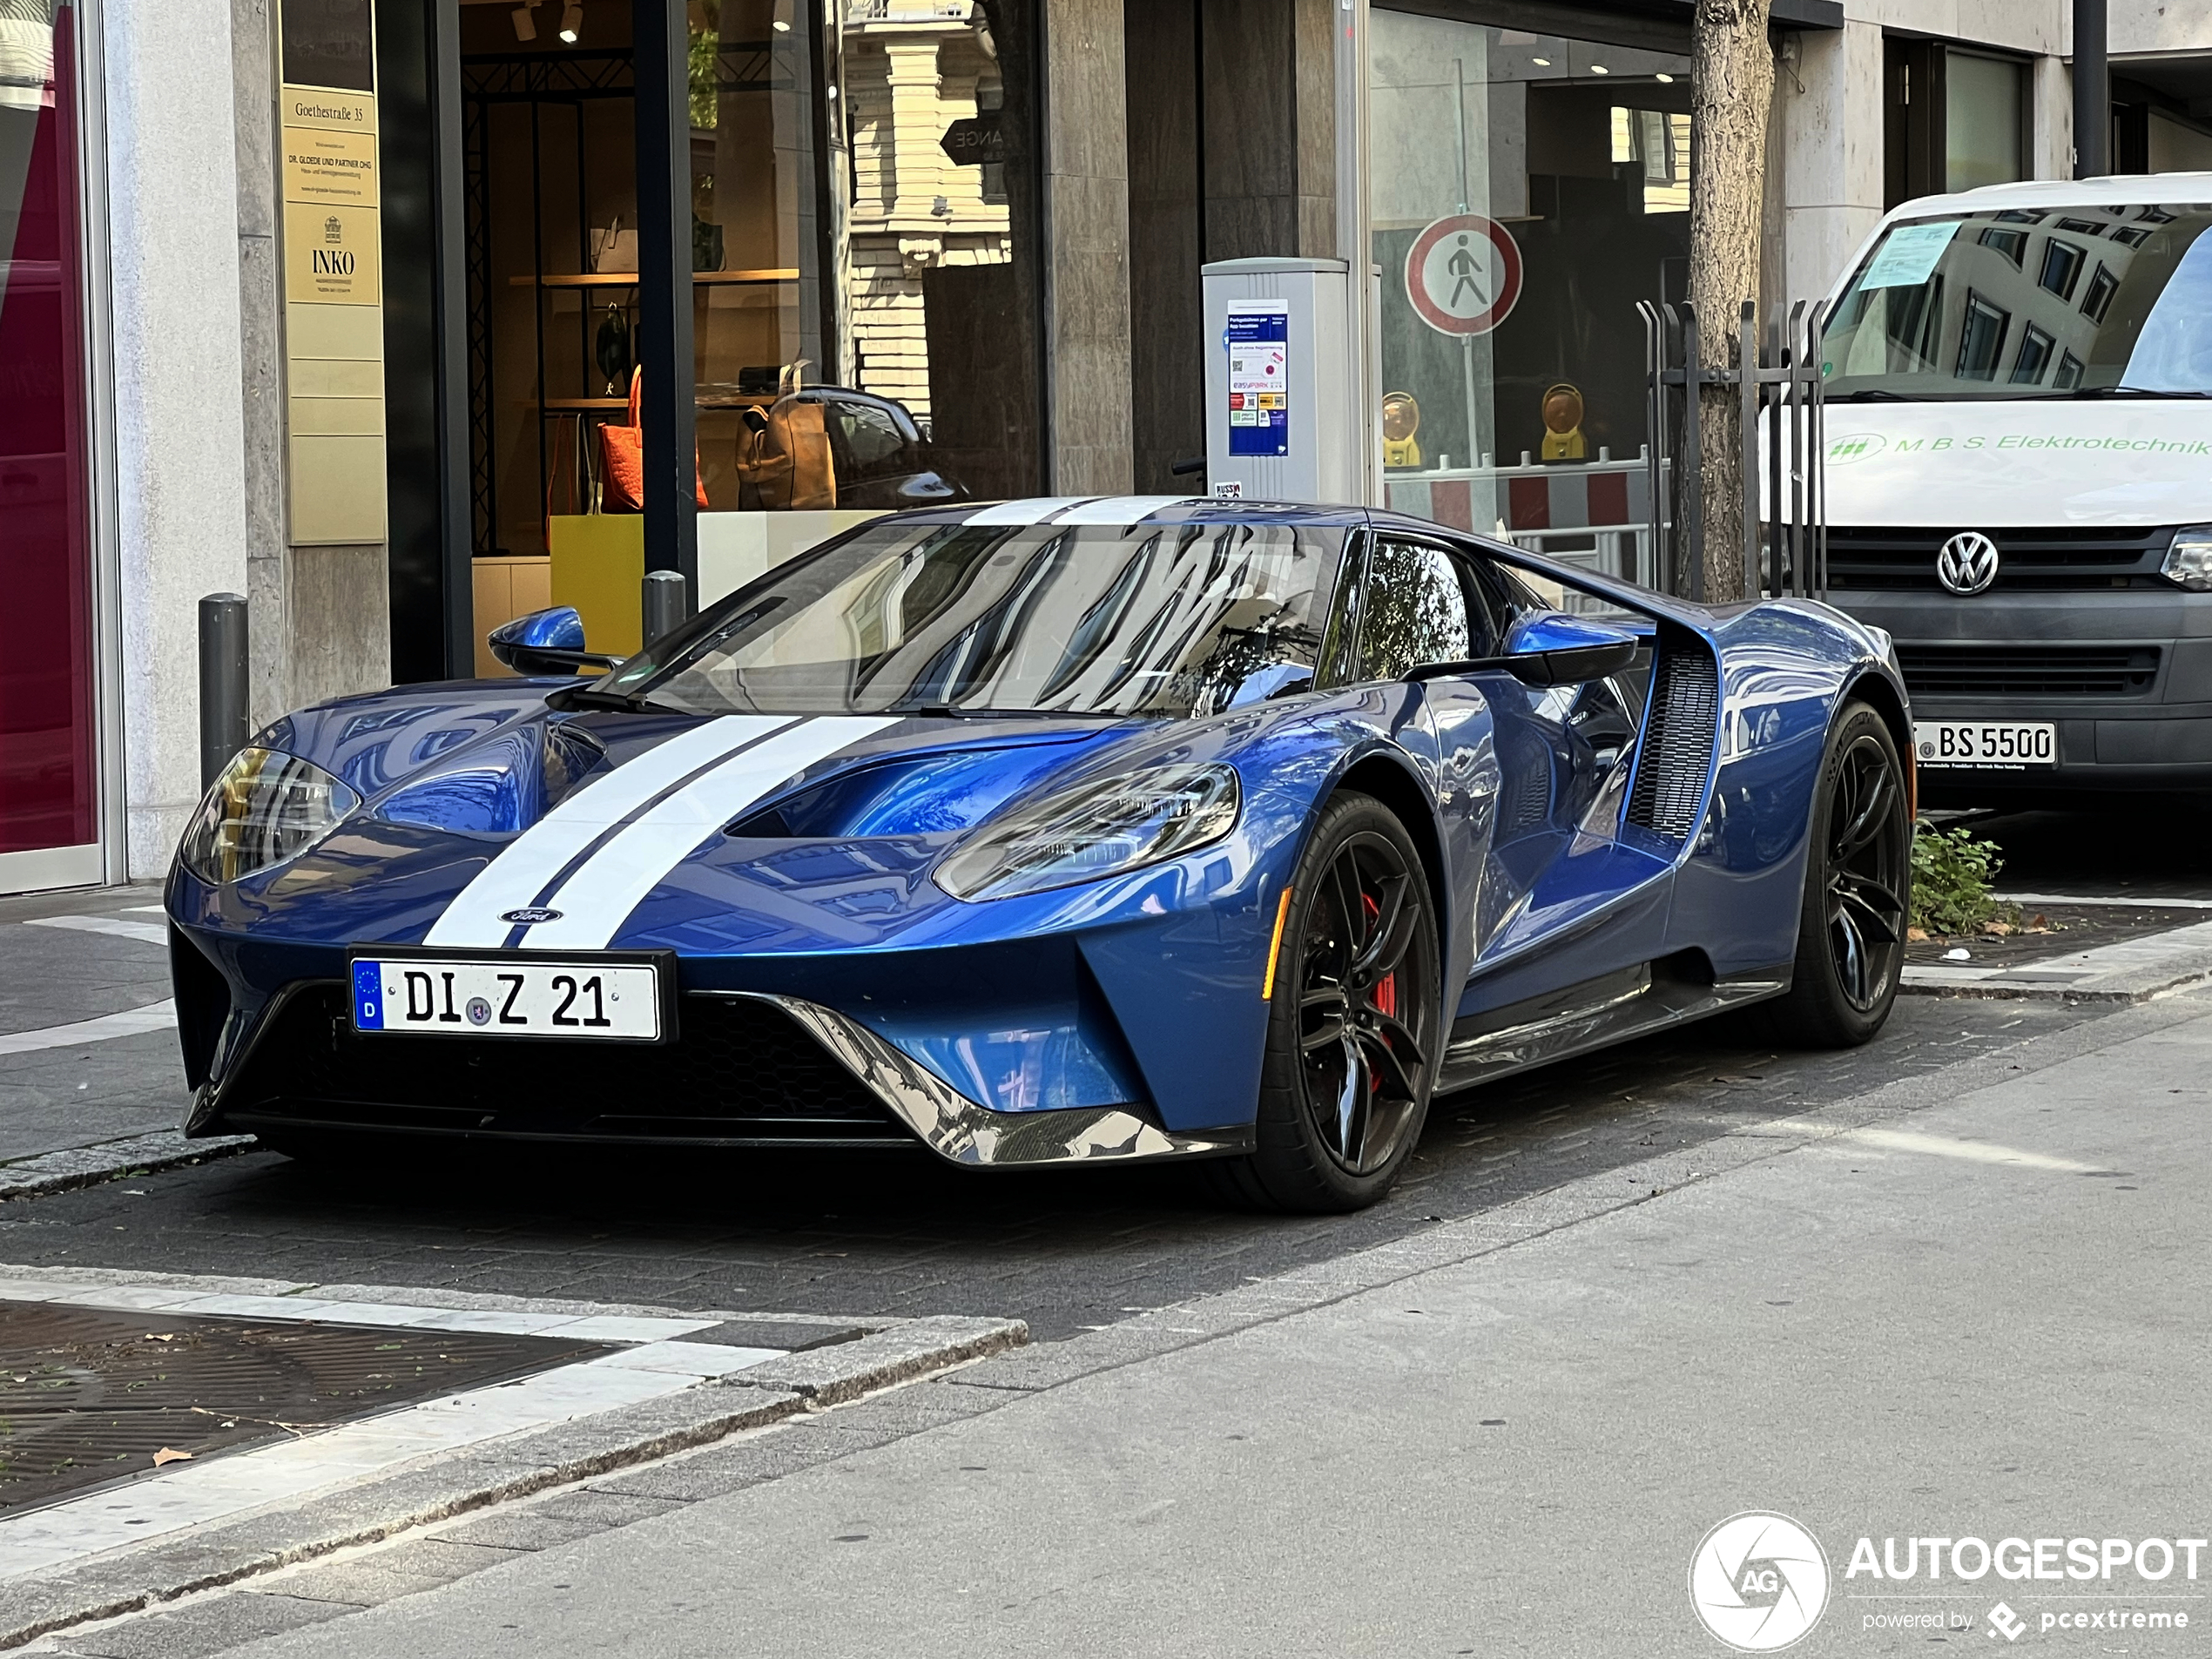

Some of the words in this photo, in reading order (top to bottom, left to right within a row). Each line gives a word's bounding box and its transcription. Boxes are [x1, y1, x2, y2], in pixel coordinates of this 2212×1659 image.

[295, 102, 351, 120] Goethestraße
[354, 107, 363, 121] 35
[288, 155, 298, 164] DR.
[299, 156, 320, 165] GLOEDE
[335, 158, 359, 169] PARTNER
[313, 249, 355, 275] INKO
[1995, 435, 2212, 455] Elektrotechnik
[1939, 727, 1974, 757] BS
[1981, 728, 2051, 758] 5500
[510, 910, 550, 921] Ford
[404, 971, 462, 1023] DI
[496, 974, 528, 1024] Z
[551, 976, 610, 1027] 21
[364, 1001, 375, 1017] D
